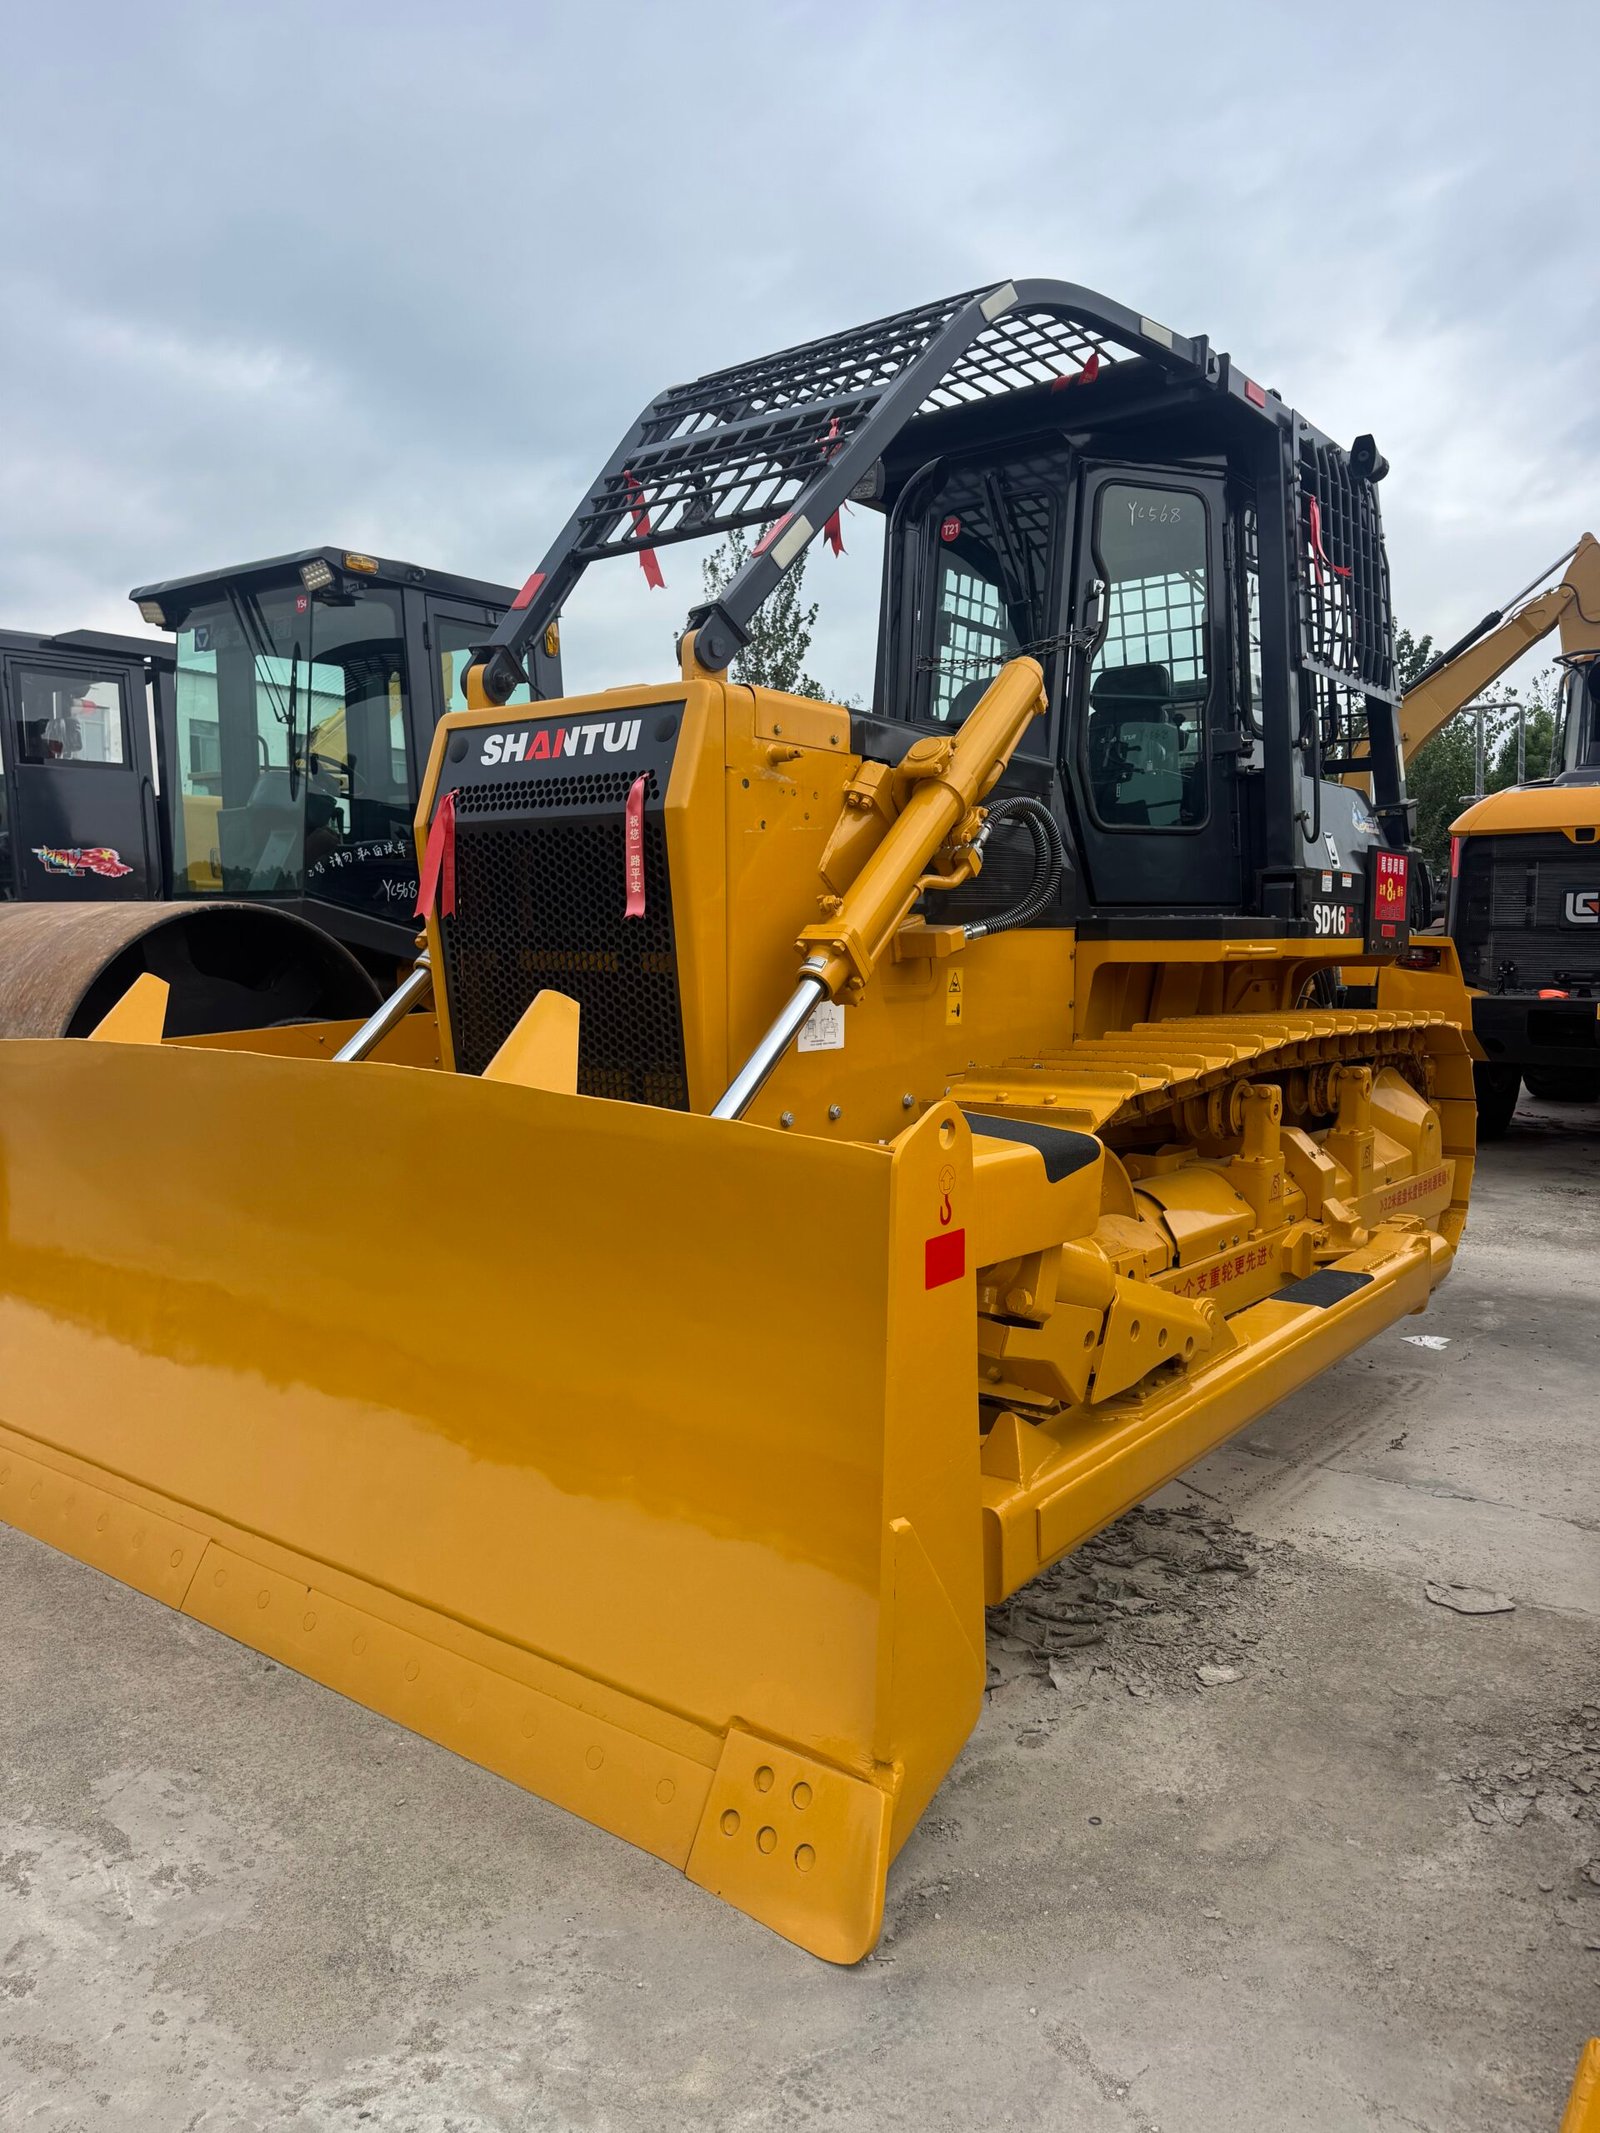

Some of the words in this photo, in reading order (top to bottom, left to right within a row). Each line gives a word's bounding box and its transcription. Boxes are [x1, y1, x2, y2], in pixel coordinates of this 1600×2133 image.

[943, 522, 960, 536] T21
[480, 719, 642, 766] SHANTUI
[629, 815, 641, 893] 祝您一路平安
[1313, 904, 1354, 935] SD16F
